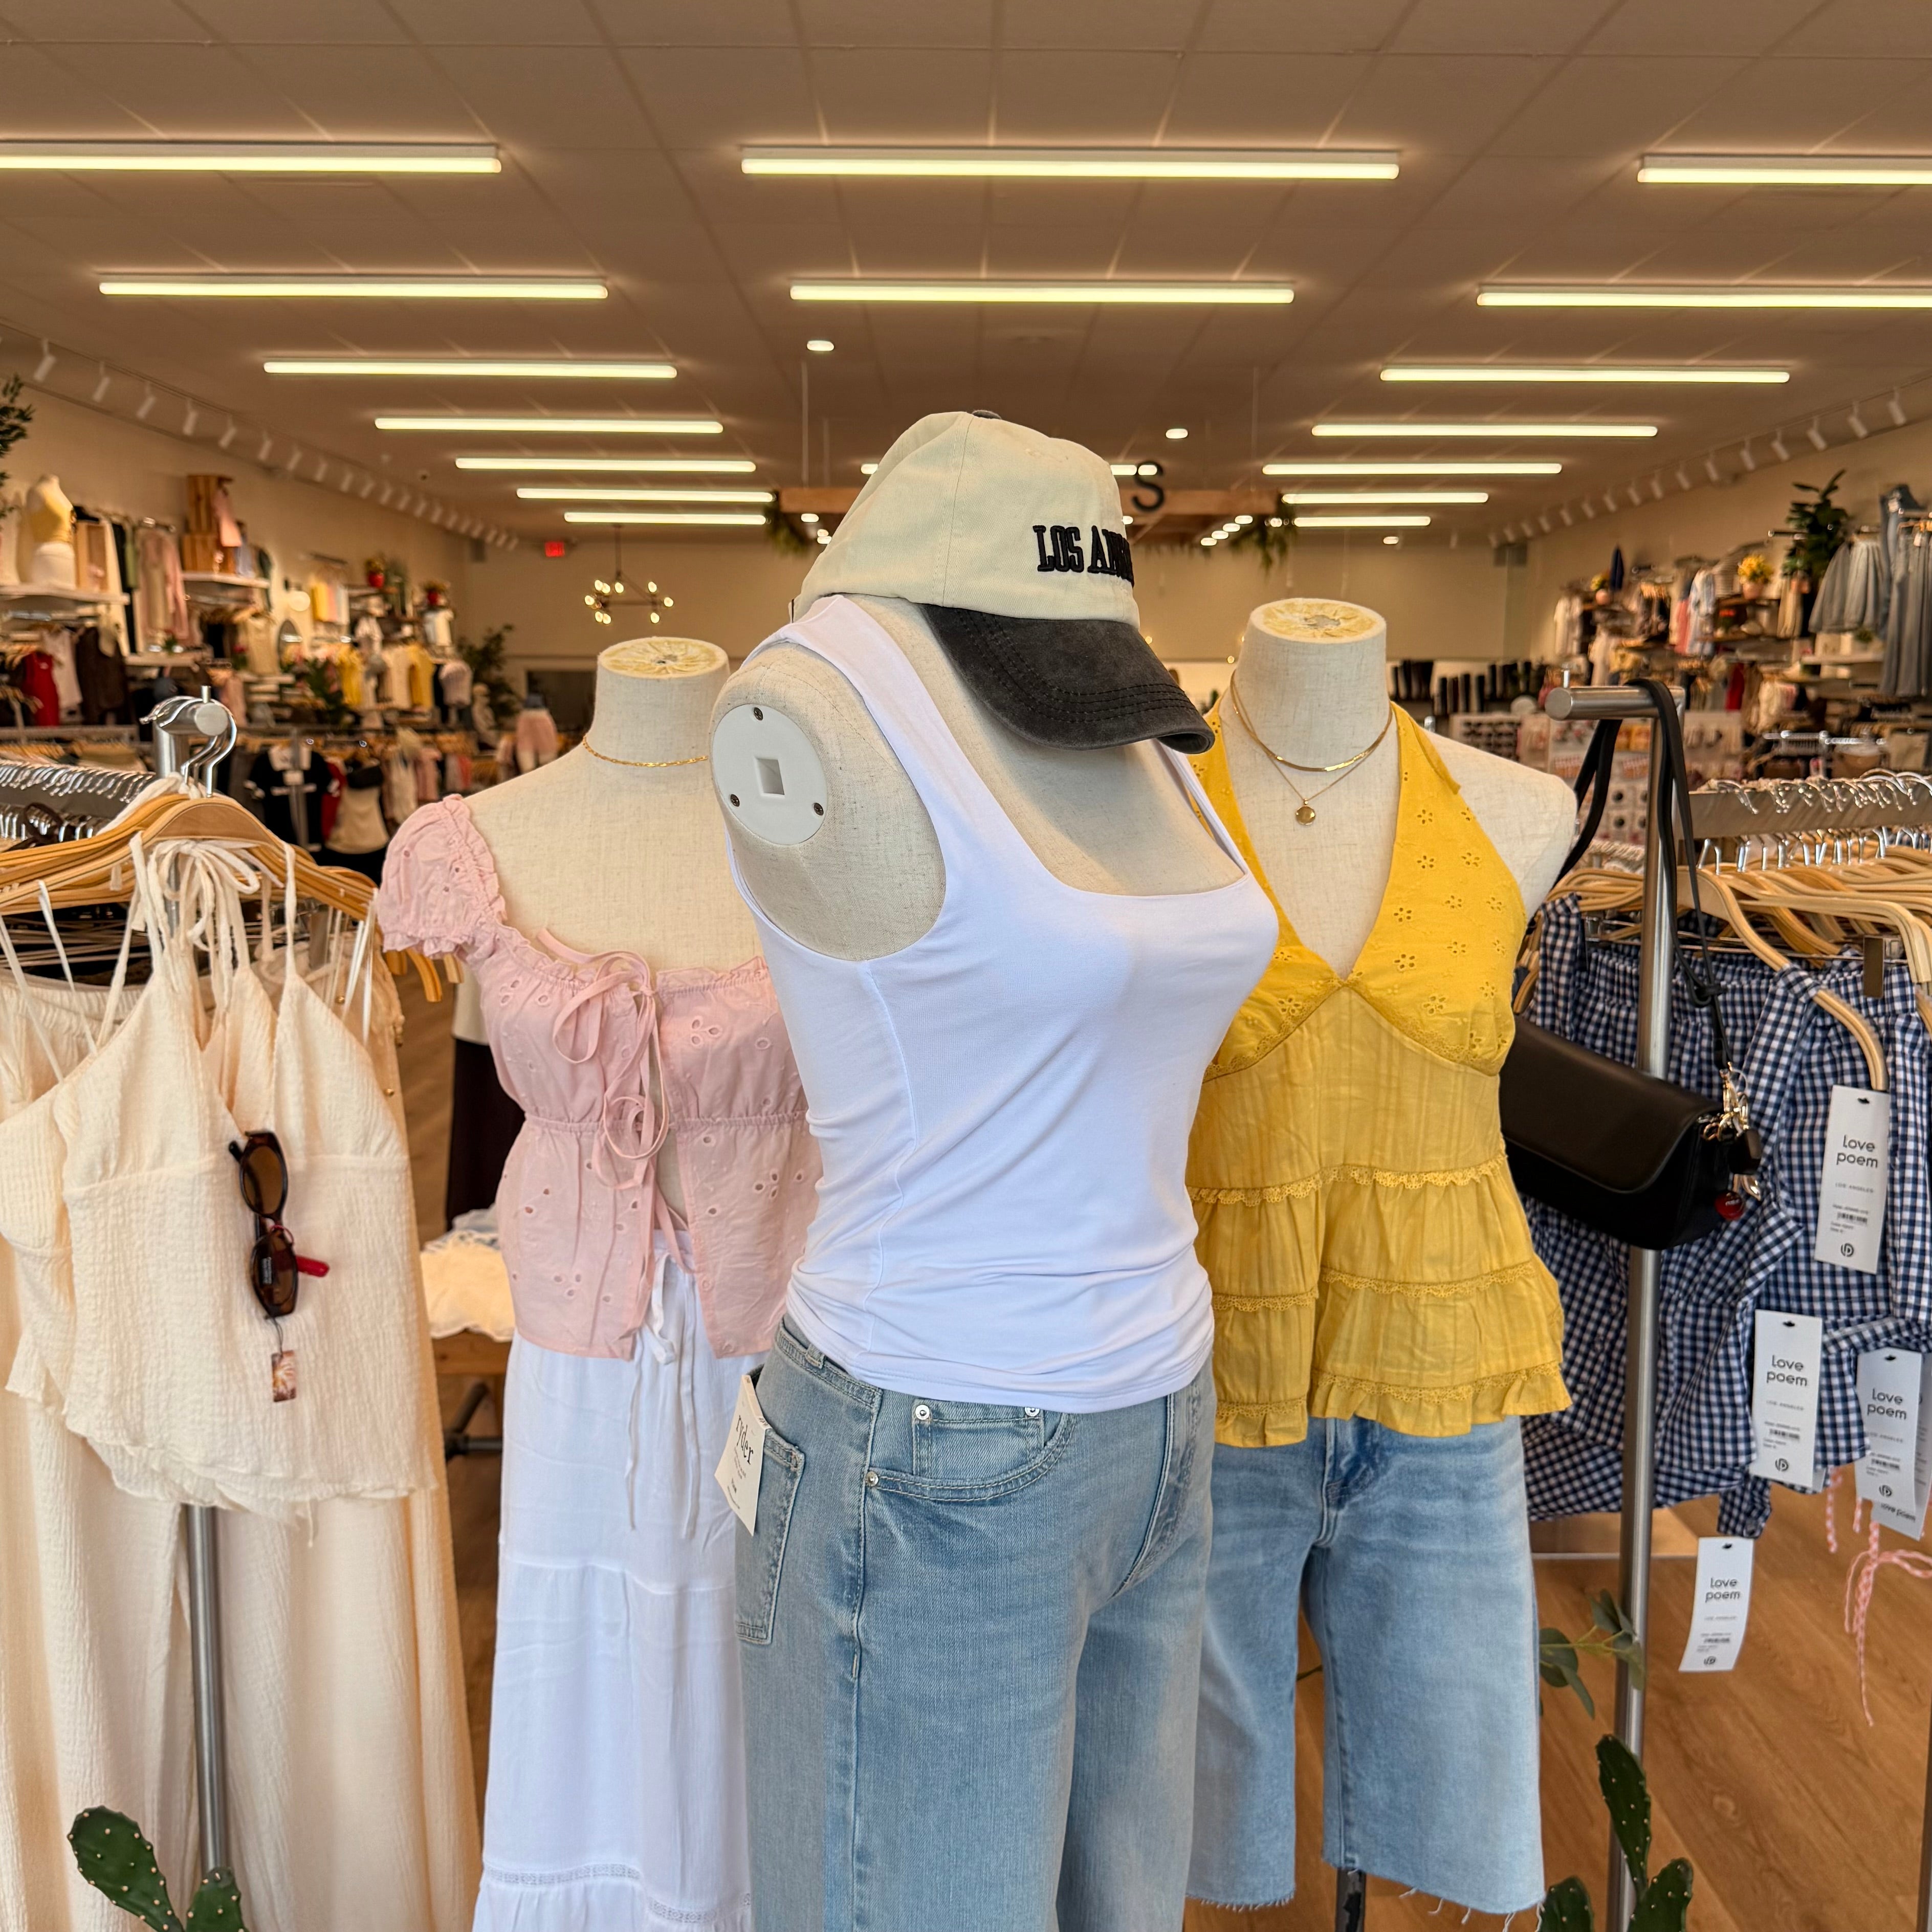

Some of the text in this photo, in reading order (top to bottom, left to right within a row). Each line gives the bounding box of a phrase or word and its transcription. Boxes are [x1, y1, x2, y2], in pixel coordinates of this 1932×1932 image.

[1033, 525, 1084, 573] LOS
[1836, 1152, 1878, 1168] poem
[1766, 1371, 1808, 1387] poem
[1867, 1404, 1907, 1420] poem
[1705, 1591, 1741, 1603] poem
